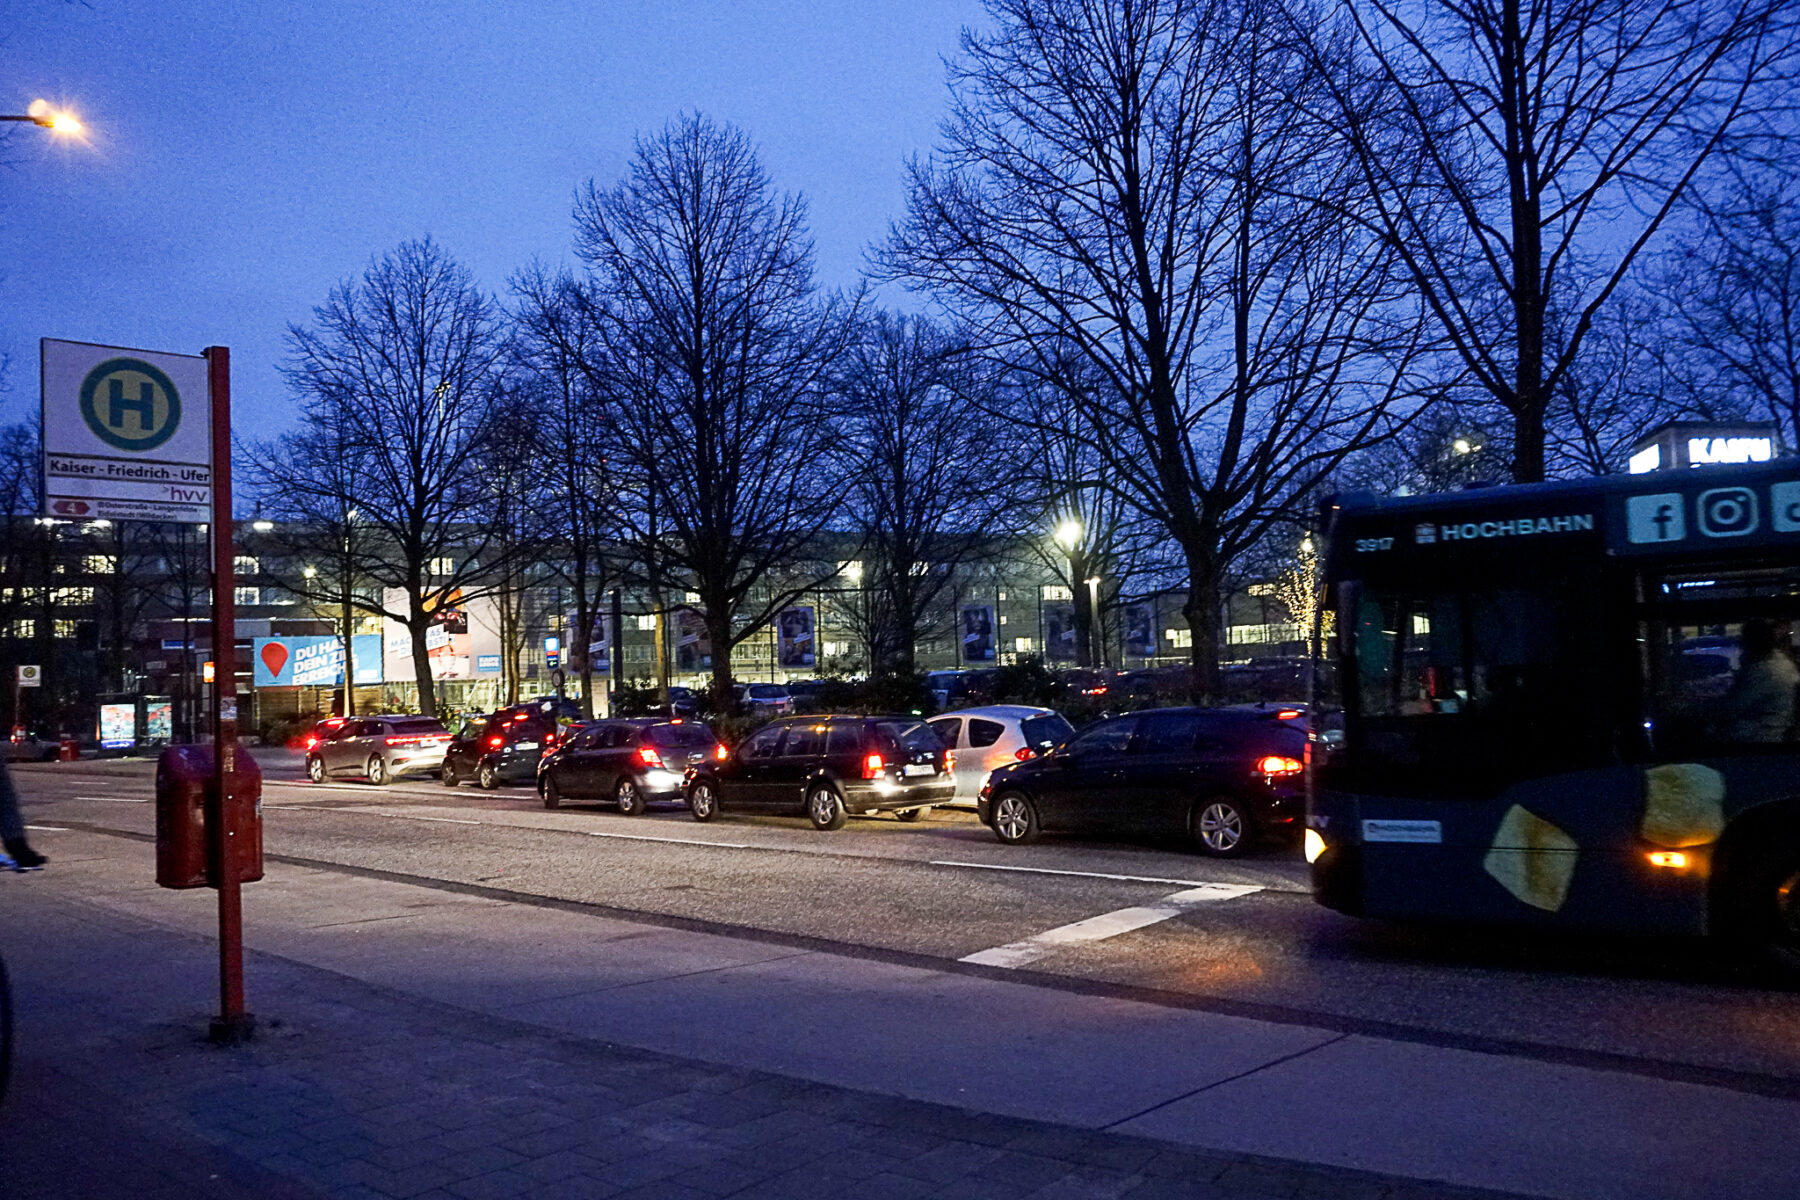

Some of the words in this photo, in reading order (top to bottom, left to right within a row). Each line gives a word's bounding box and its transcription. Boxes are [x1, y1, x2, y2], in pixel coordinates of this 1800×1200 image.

[108, 379, 154, 431] H
[50, 460, 96, 474] Kaiser
[108, 464, 170, 479] Friedrich
[181, 469, 210, 481] Ufer
[170, 486, 207, 502] hvv
[1441, 514, 1593, 541] HOCHBAHN
[295, 644, 317, 661] DU
[293, 654, 328, 674] DEIN
